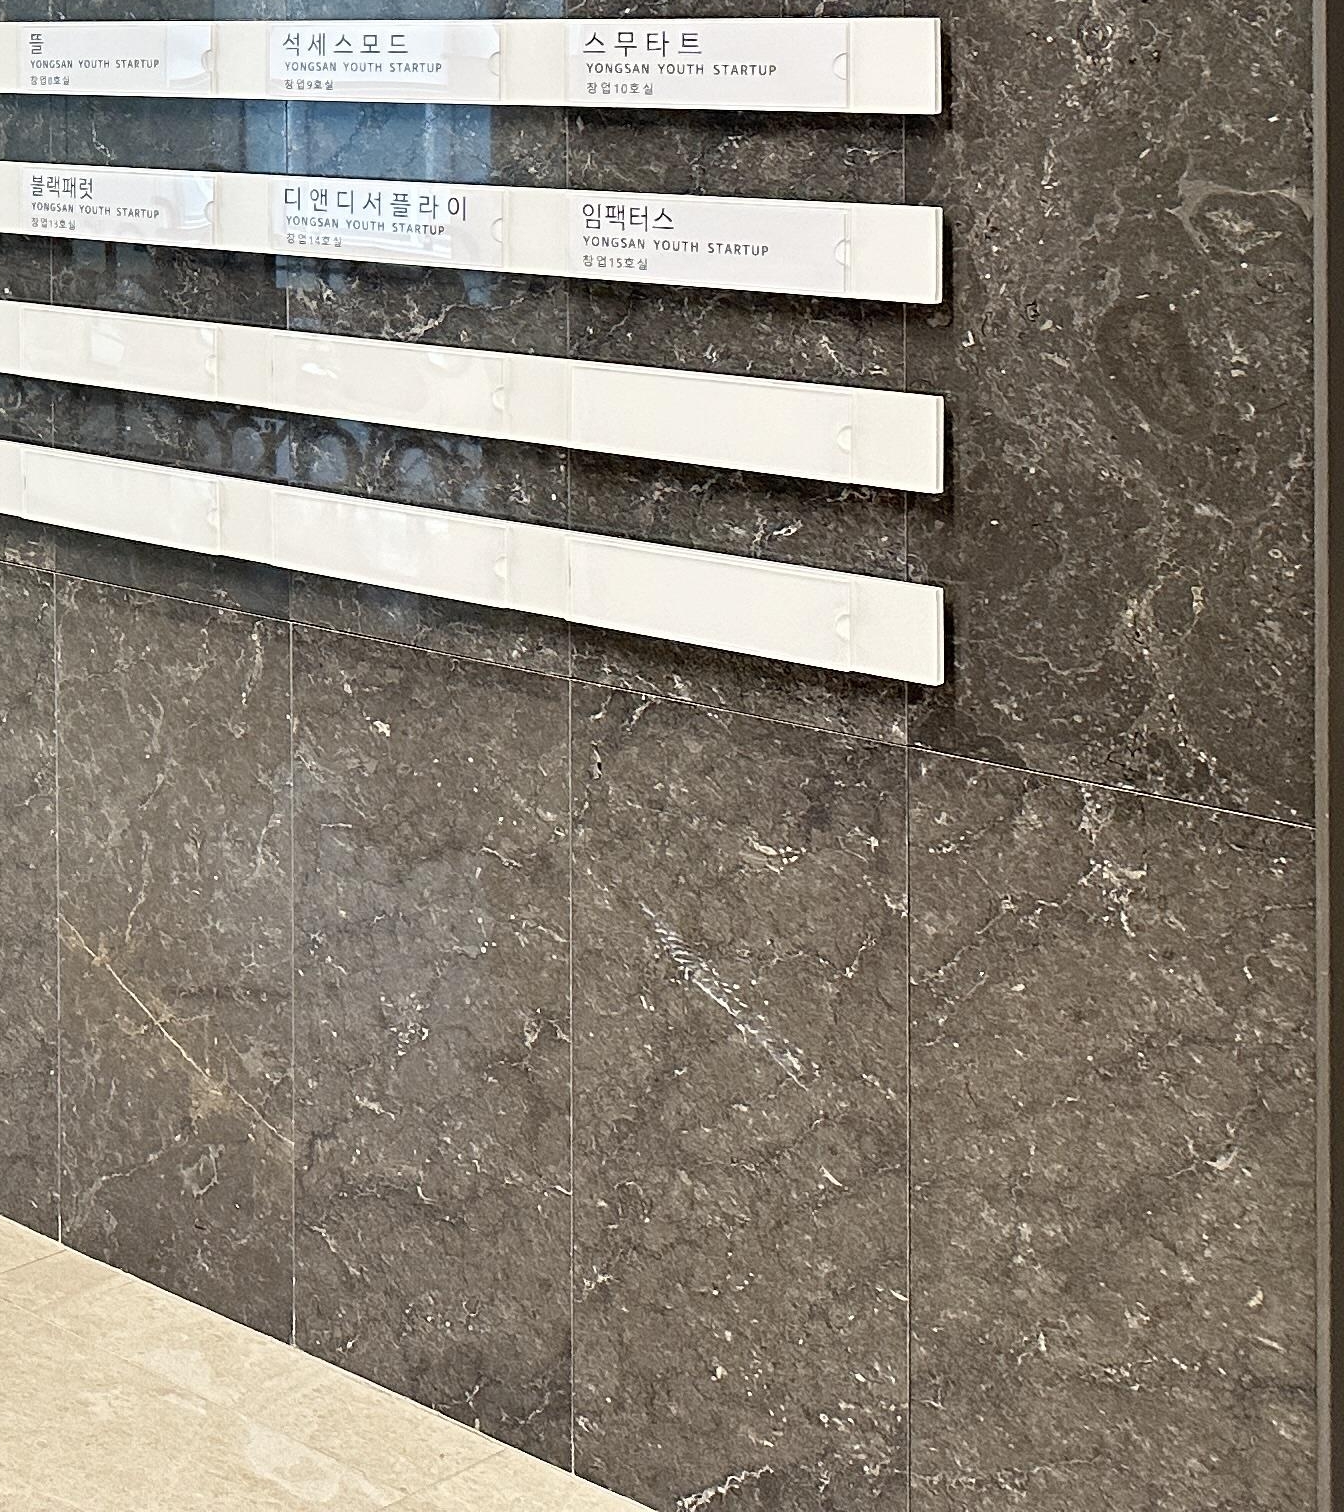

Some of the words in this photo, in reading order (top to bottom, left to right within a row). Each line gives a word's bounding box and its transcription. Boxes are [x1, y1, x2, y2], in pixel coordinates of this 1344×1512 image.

[282, 32, 409, 57] 석세스모드
[582, 30, 702, 58] 스무타트
[30, 59, 73, 69] YONGSAN
[78, 59, 110, 69] YOUTH
[115, 58, 160, 69] STARTUP
[284, 61, 337, 72] YONGSAN
[342, 61, 383, 73] YOUTH
[389, 62, 442, 73] STARTUP
[585, 62, 650, 74] YONGSAN
[657, 63, 704, 75] YOUTH
[713, 64, 777, 76] STARTUP
[283, 78, 334, 91] 창업9호실
[586, 81, 654, 96] 창업10호실
[31, 201, 74, 213] YONGSAN
[78, 204, 111, 216] YOUTH
[116, 207, 160, 219] STARTUP
[284, 186, 470, 223] 디앤디서플라이
[285, 215, 339, 229] YONGSAN
[345, 219, 385, 232] YOUTH
[391, 222, 445, 236] STARTUP
[582, 203, 675, 232] 임팩터스
[582, 235, 646, 250] YONGSAN
[652, 239, 699, 253] YOUTH
[707, 242, 769, 257] STARTUP
[582, 254, 648, 271] 창업15호실
